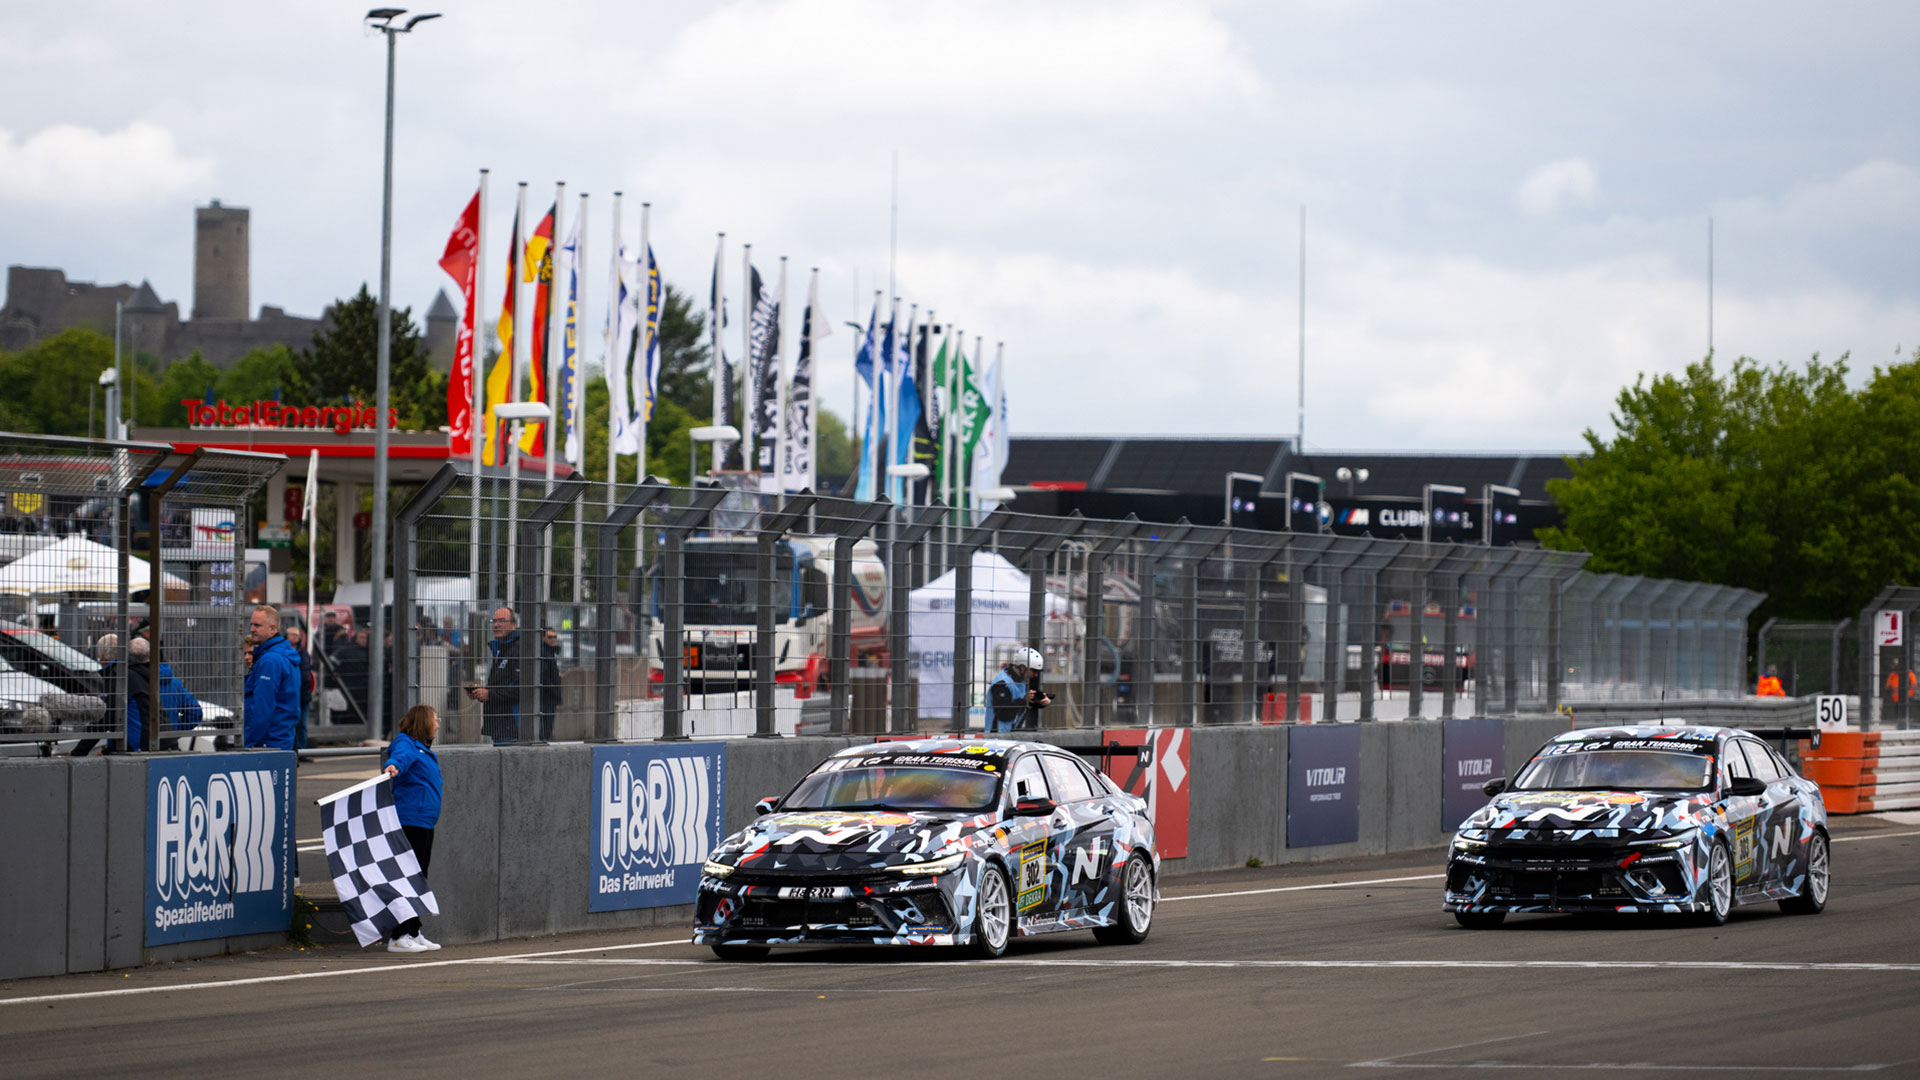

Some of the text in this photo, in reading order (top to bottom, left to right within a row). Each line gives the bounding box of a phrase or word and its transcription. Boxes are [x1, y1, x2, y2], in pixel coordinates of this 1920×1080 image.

[181, 399, 398, 434] TotalEnergies
[1820, 698, 1843, 722] 50
[1140, 750, 1149, 762] N
[1613, 740, 1647, 748] GRAN
[1648, 741, 1698, 750] TURISMO
[894, 755, 929, 763] GRAN
[930, 756, 984, 767] TURISMO
[1458, 758, 1493, 777] VITOUR
[1306, 766, 1347, 787] VITOUR
[601, 759, 674, 872] H&R
[156, 774, 236, 902] H&R
[1771, 816, 1794, 860] N
[1071, 836, 1103, 885] N
[599, 869, 675, 894] Das Fahrwerk!
[1026, 860, 1040, 888] 302
[1025, 890, 1042, 905] DEKRA
[155, 901, 234, 932] Spezialfedern
